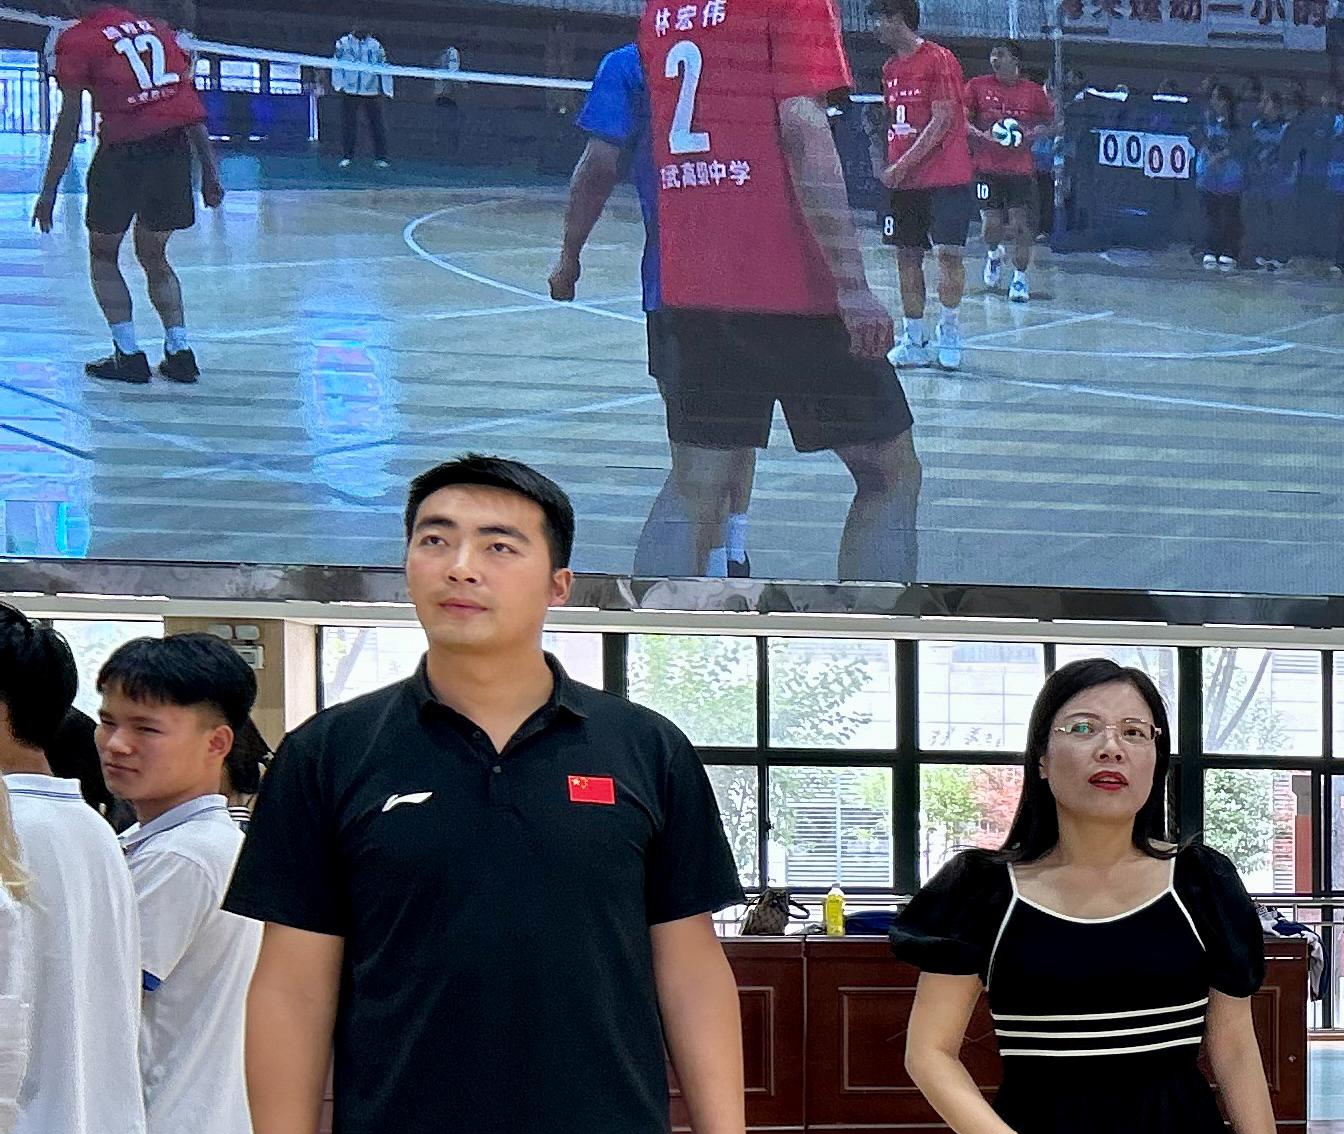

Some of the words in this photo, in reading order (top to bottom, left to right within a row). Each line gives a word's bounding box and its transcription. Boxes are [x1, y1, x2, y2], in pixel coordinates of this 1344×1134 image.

[114, 34, 180, 90] 12
[665, 40, 711, 154] 2
[1103, 134, 1142, 163] 00
[1149, 145, 1186, 173] 00
[976, 183, 990, 200] 10
[884, 216, 894, 237] 8
